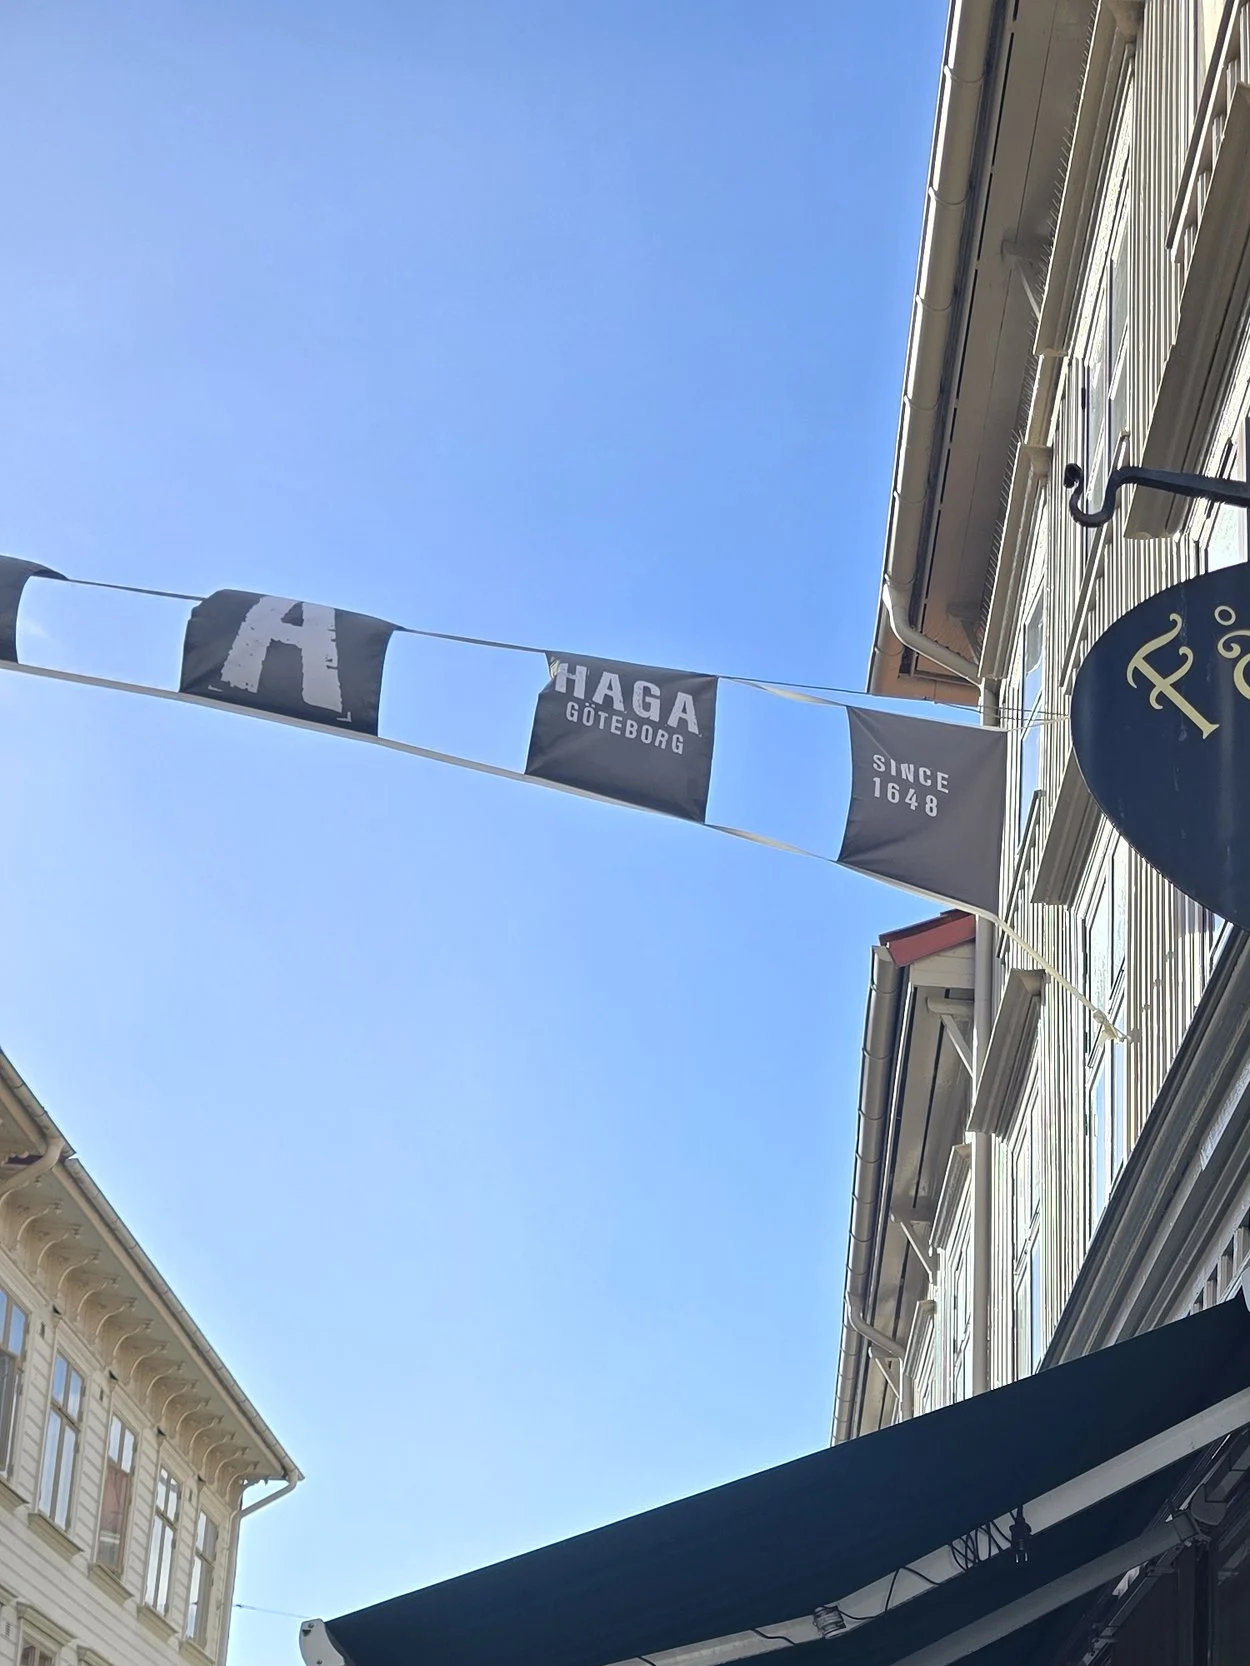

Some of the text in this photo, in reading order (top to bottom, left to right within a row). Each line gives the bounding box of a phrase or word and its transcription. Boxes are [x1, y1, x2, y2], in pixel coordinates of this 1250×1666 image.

[218, 595, 344, 716] A
[555, 660, 702, 736] HAGA
[565, 700, 685, 757] GÖTEBORG
[871, 753, 951, 795] SINCE
[871, 776, 939, 818] 1648
